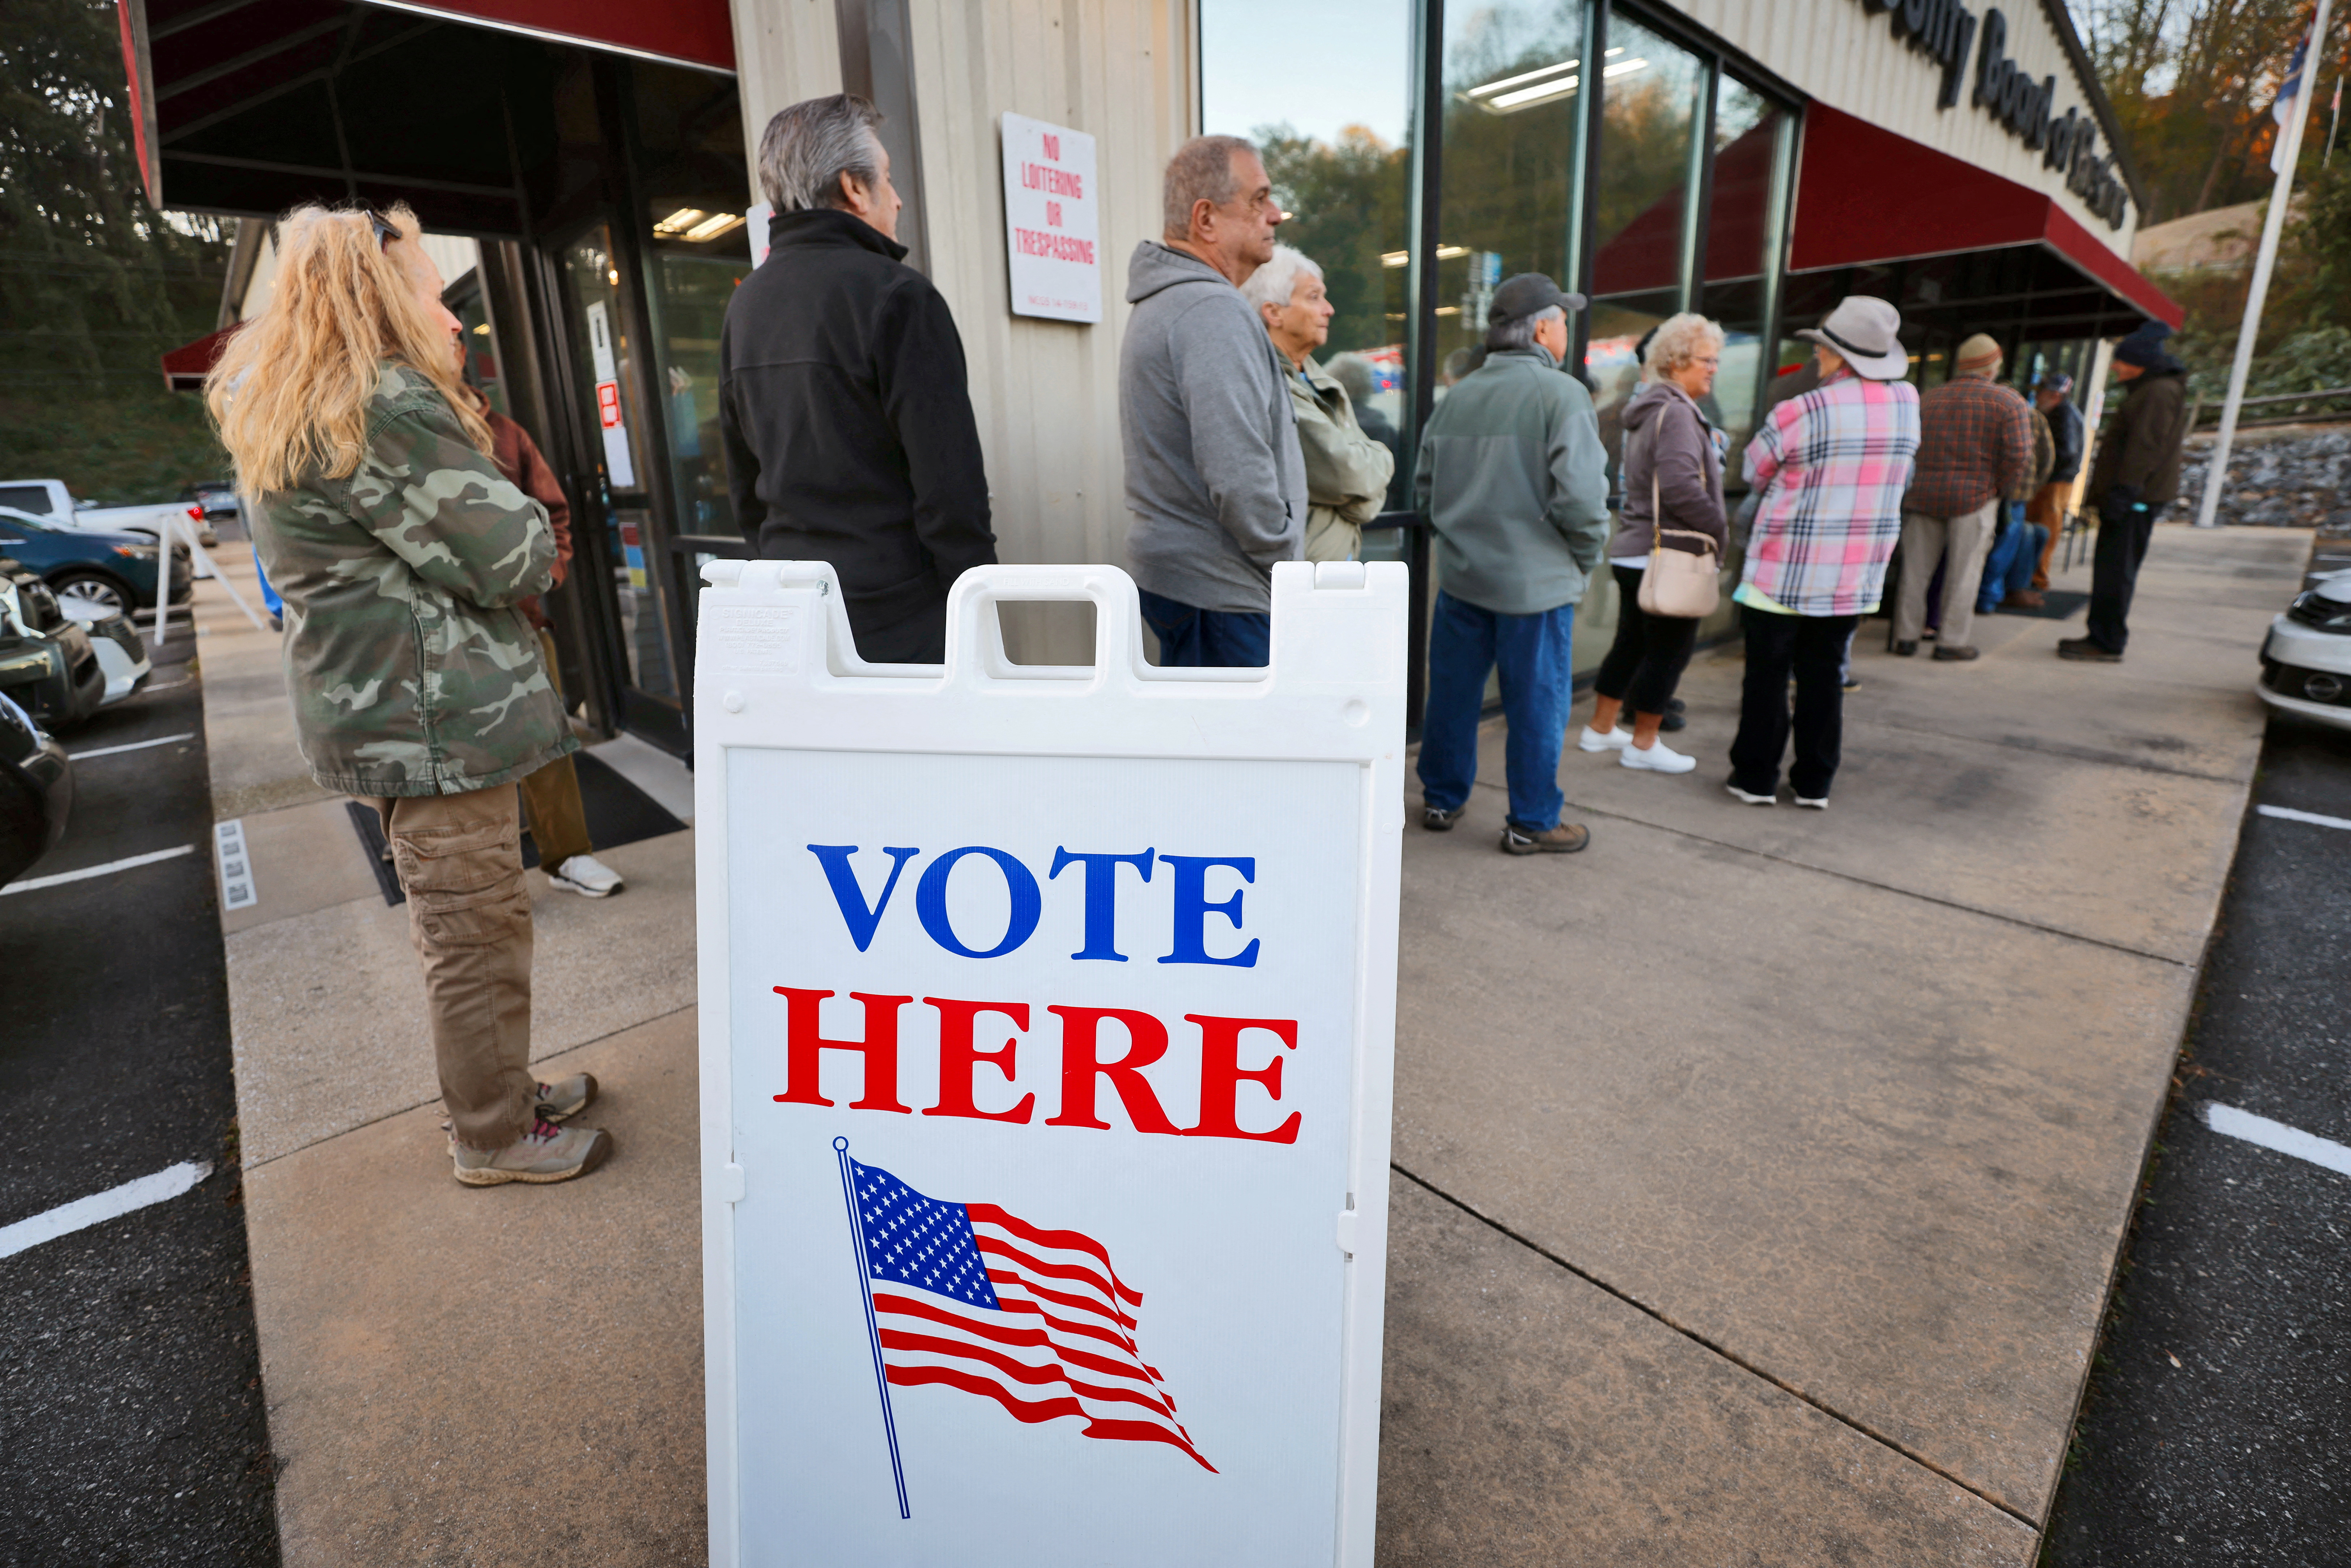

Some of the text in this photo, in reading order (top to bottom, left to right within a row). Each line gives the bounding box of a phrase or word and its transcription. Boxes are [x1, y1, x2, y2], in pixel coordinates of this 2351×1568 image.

[1043, 133, 1060, 161] NO
[1021, 162, 1082, 199] LOITERING
[1046, 200, 1062, 227] OR
[1015, 228, 1094, 265] TRESPASSING
[807, 844, 1260, 968] VOTE
[773, 986, 1301, 1144] HERE
